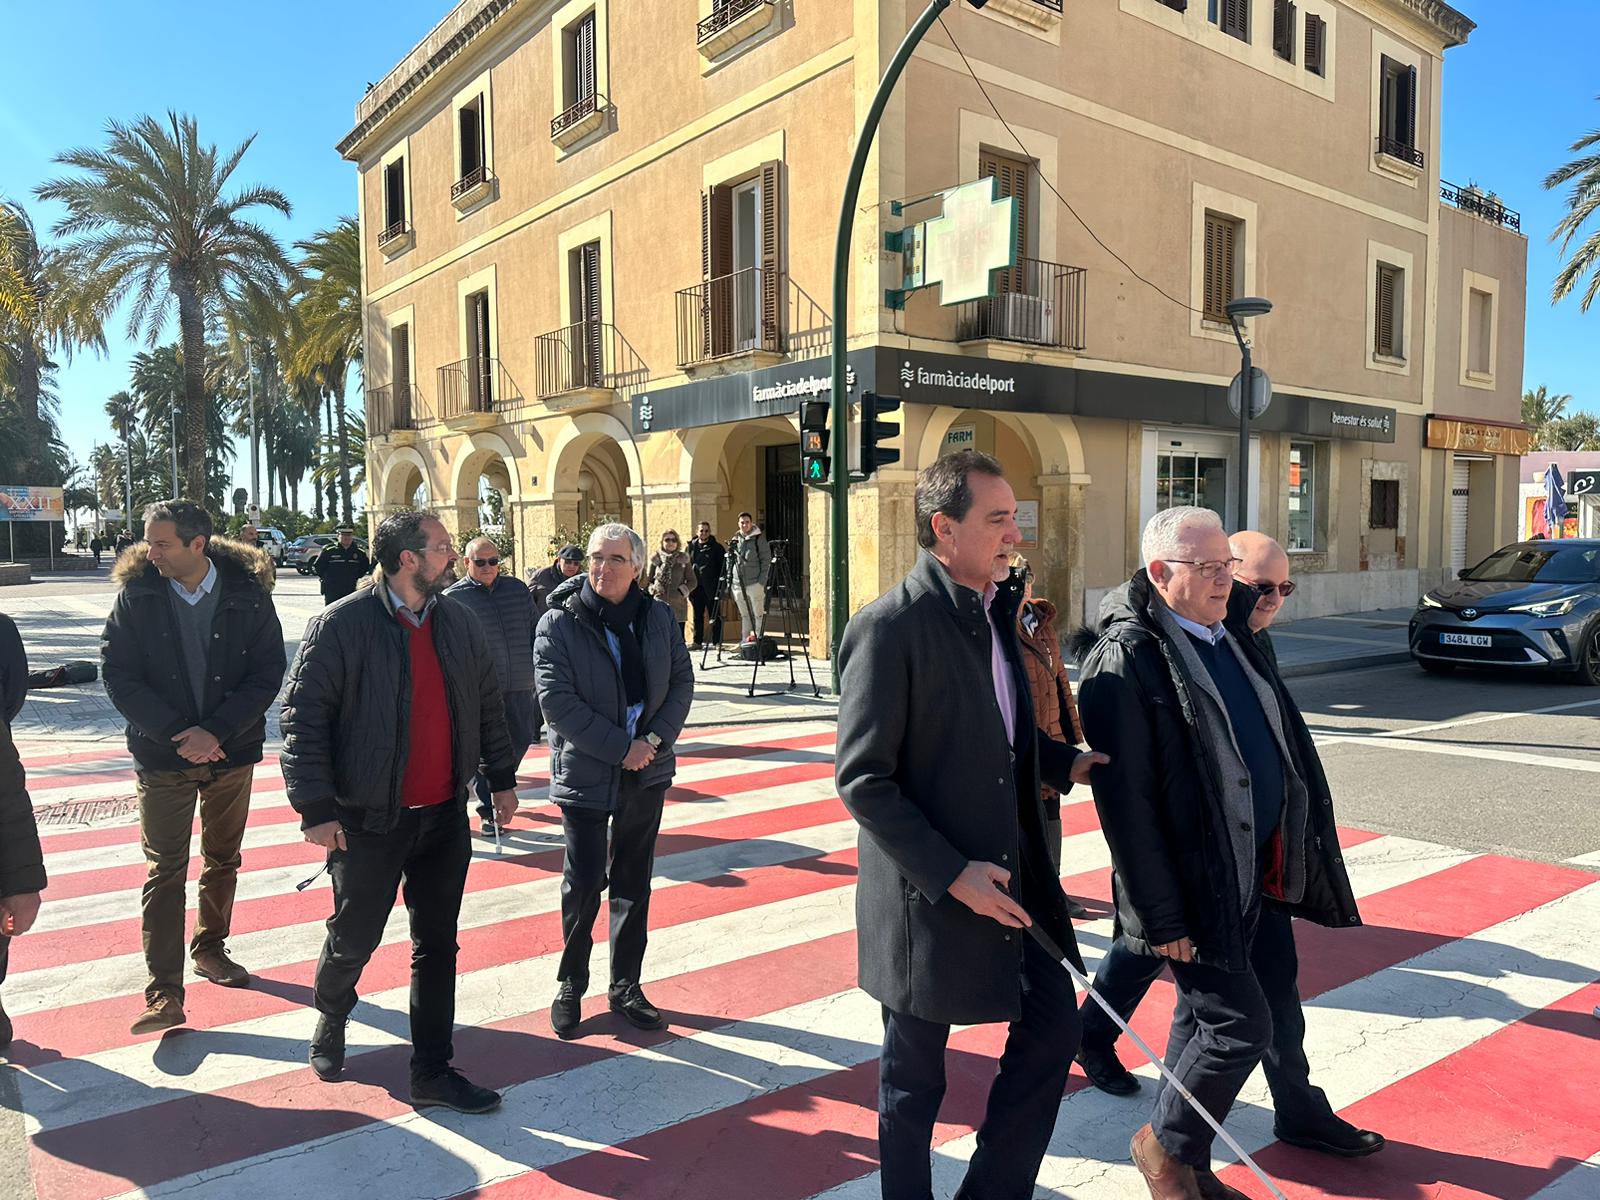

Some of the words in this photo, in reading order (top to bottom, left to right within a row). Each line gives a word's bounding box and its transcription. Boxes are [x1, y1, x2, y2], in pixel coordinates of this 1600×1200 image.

[752, 375, 833, 402] farmàciadelpor
[917, 367, 1015, 395] farmàciadelport
[1332, 411, 1360, 426] benestar
[1360, 415, 1367, 427] és
[1367, 416, 1383, 429] salut
[947, 430, 973, 444] FARM
[1446, 634, 1469, 645] 3484
